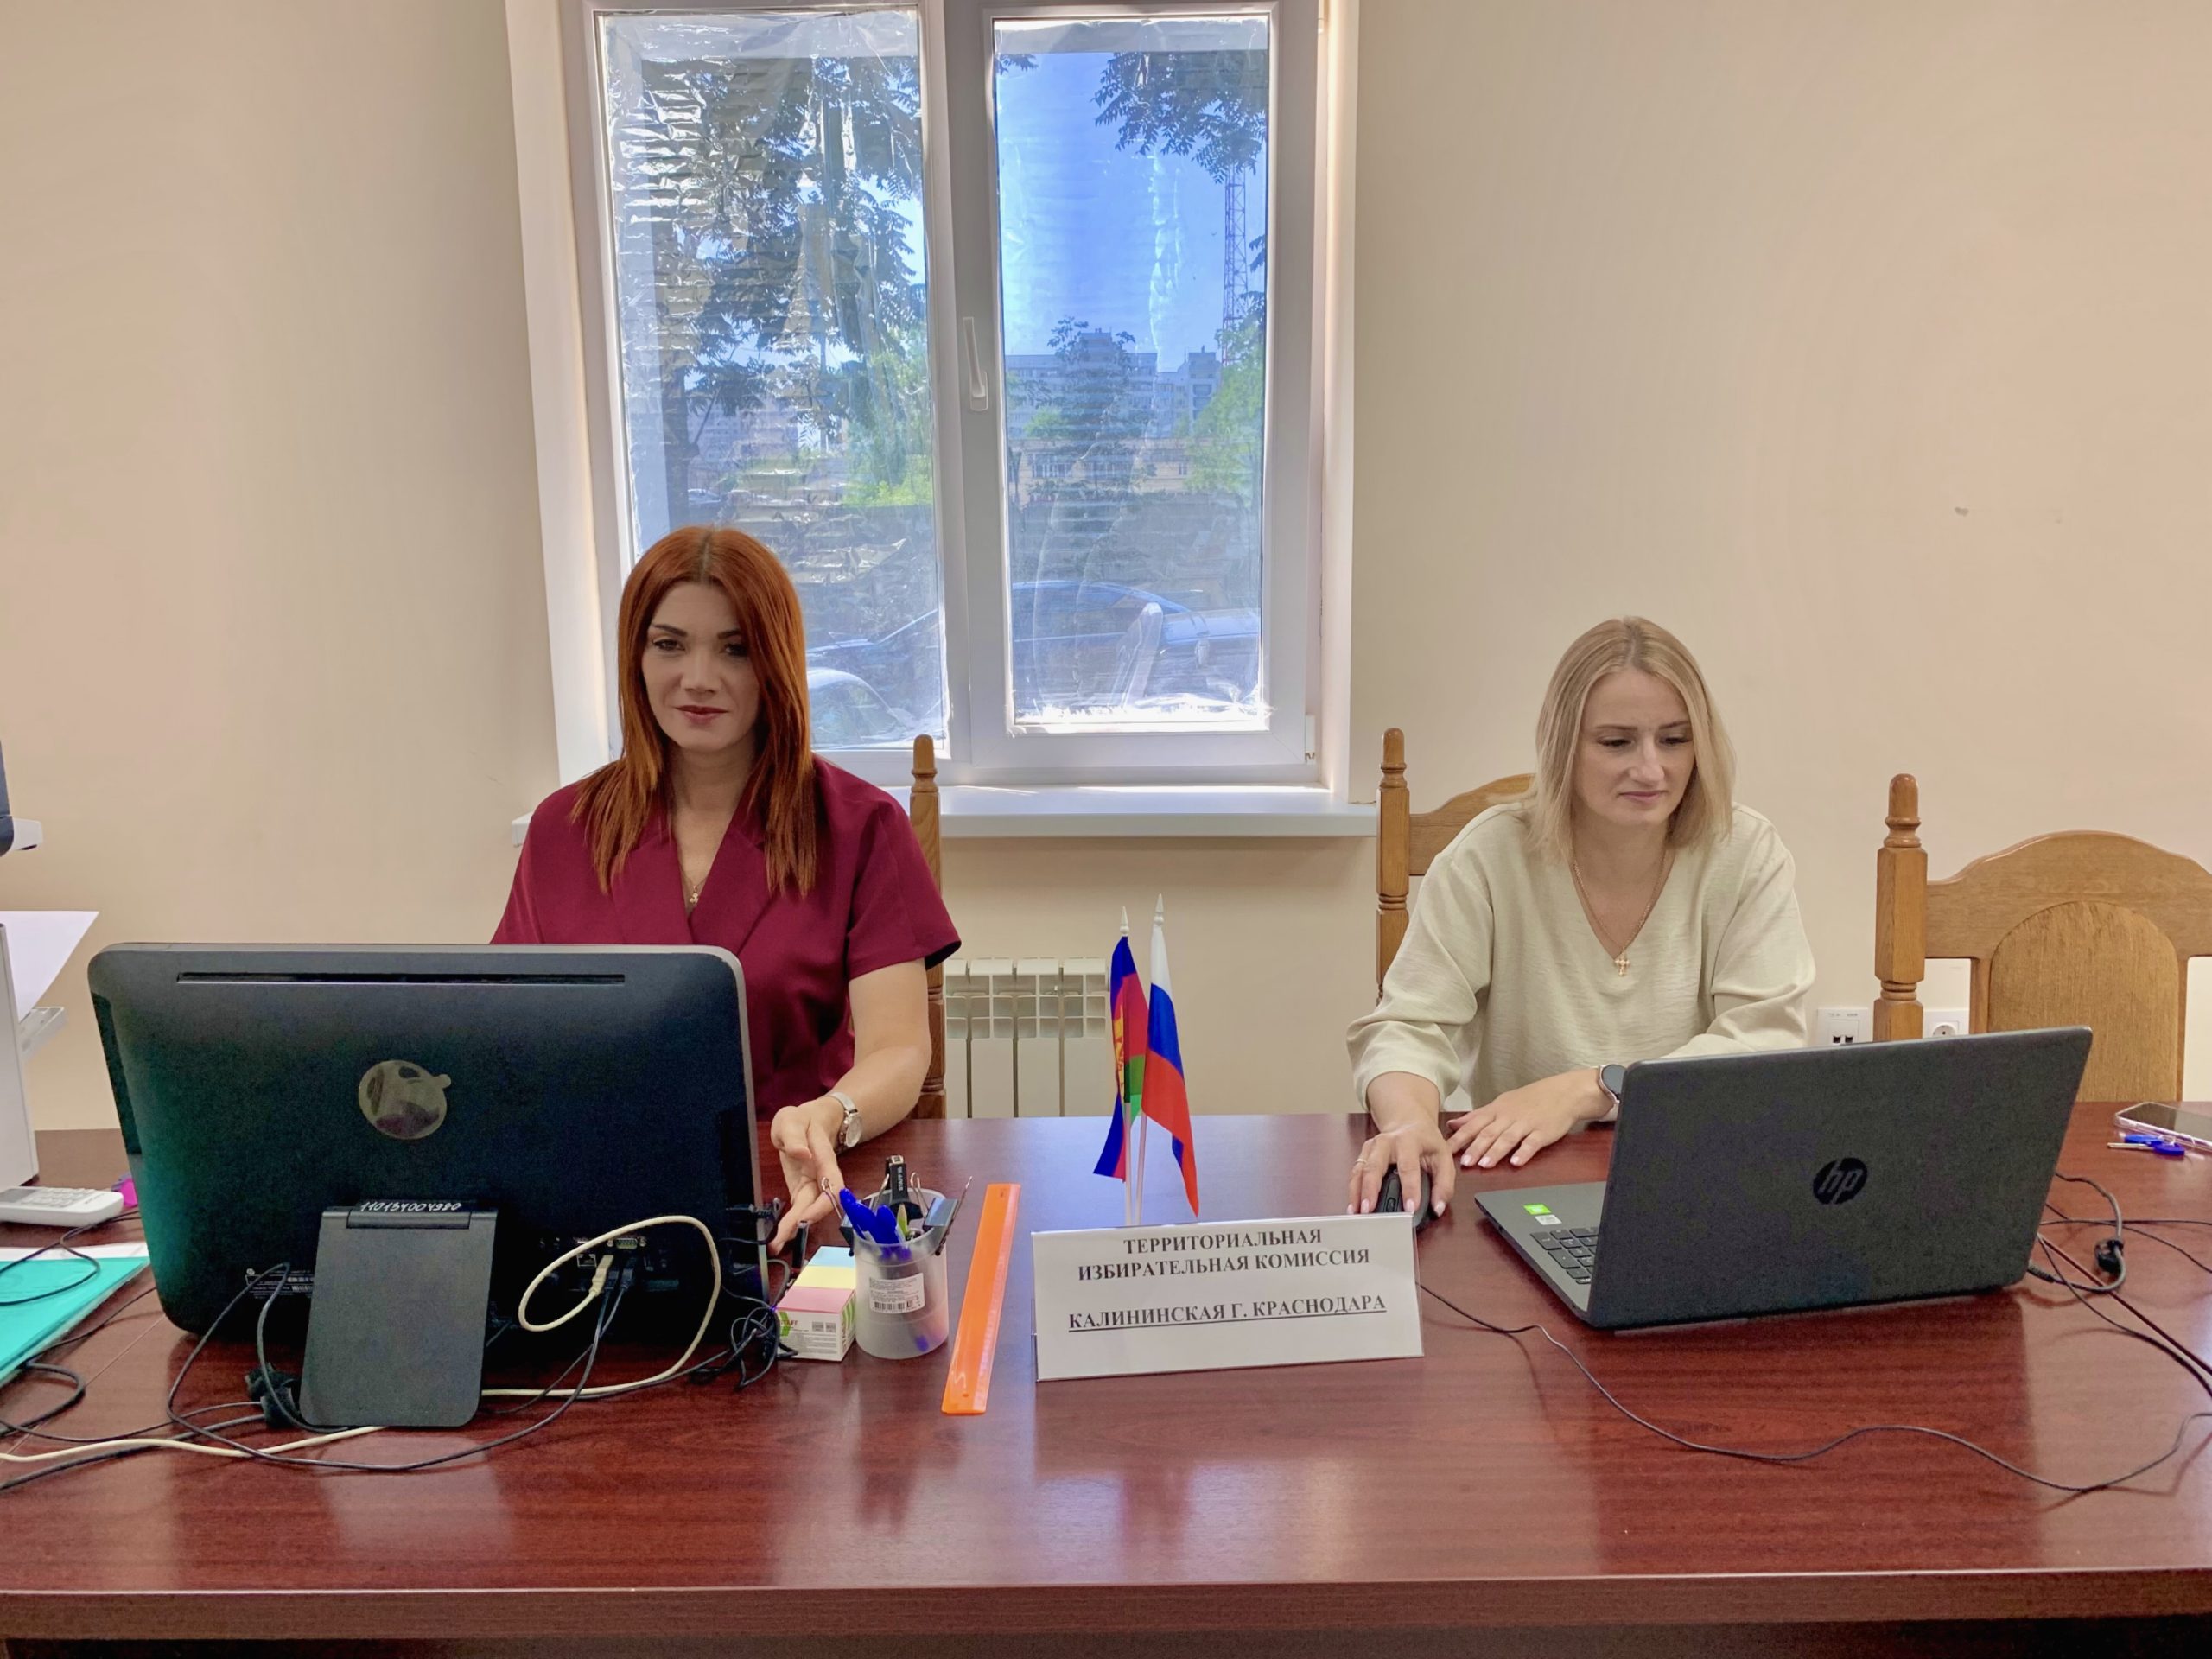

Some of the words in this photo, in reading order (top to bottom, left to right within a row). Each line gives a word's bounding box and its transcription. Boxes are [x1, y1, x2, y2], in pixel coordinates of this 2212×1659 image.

[1817, 1161, 1864, 1203] hp
[1123, 1229, 1322, 1254] ТЕРРИТОРИАЛЬНАЯ
[1078, 1256, 1249, 1281] ИЗБИРАТЕЛЬНАЯ
[1255, 1249, 1370, 1270] КОМИССИЯ
[1069, 1304, 1225, 1331] КАЛИНИНСКАЯ
[1231, 1303, 1248, 1319] Г.
[1252, 1294, 1386, 1317] КРАСНОДАРА
